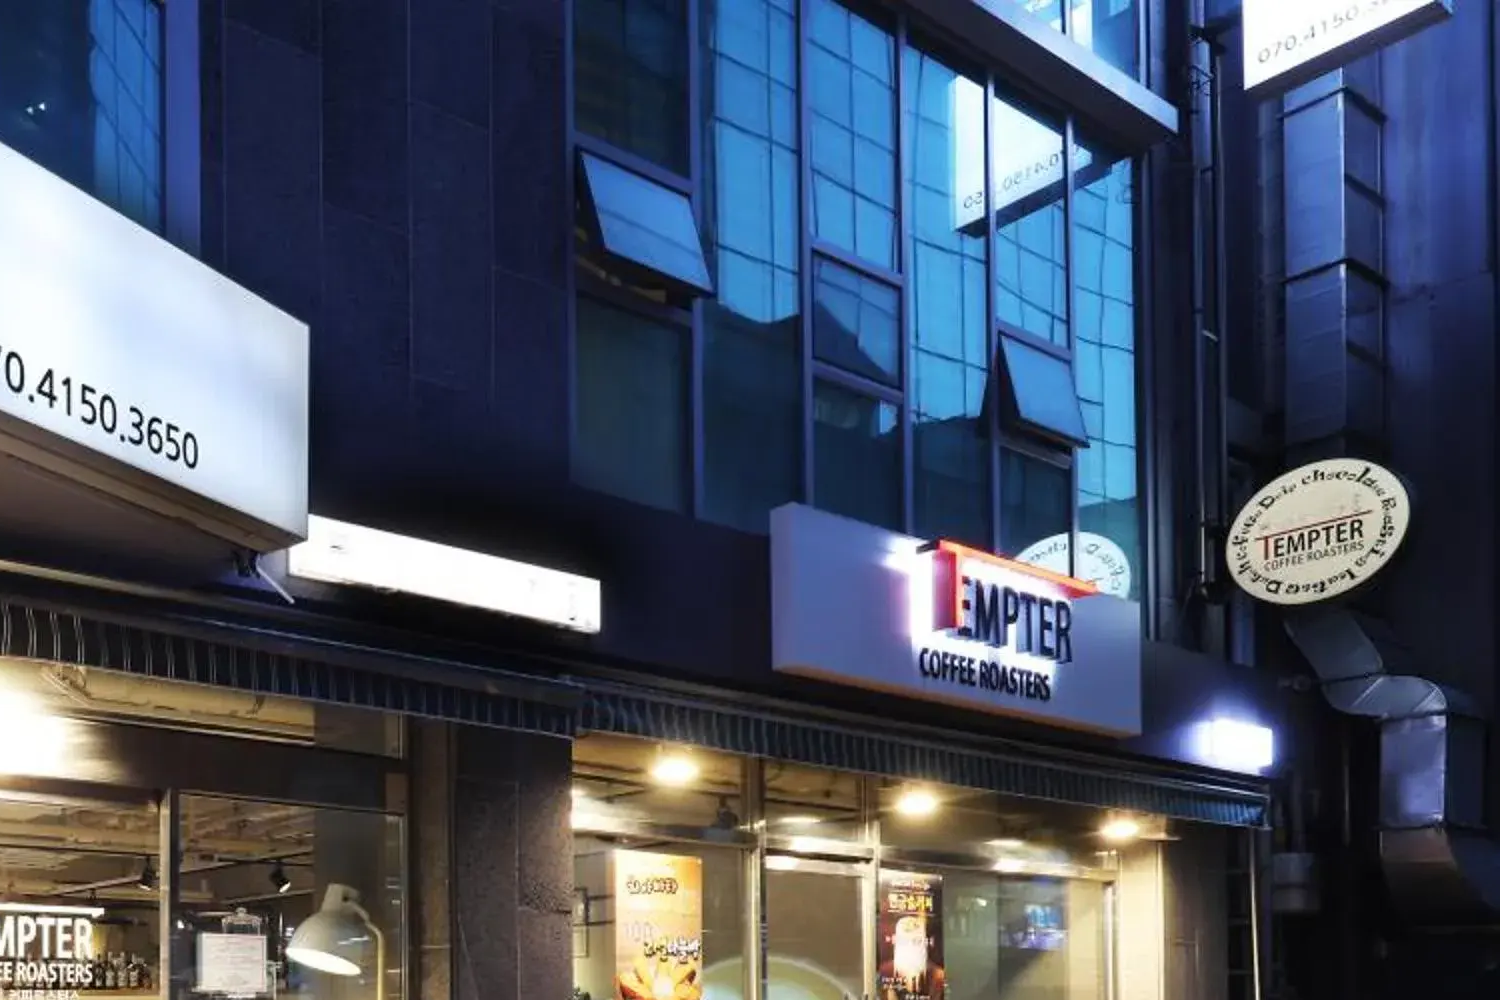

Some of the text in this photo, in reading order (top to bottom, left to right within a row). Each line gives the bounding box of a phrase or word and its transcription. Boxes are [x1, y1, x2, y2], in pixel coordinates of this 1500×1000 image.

[1255, 510, 1373, 561] TEMPTER
[1263, 540, 1365, 573] COFFEE ROASTERS
[916, 539, 1100, 666] TEMPTER
[919, 647, 1052, 702] COFFEE ROASTERS
[16, 962, 93, 984] ROASTERS
